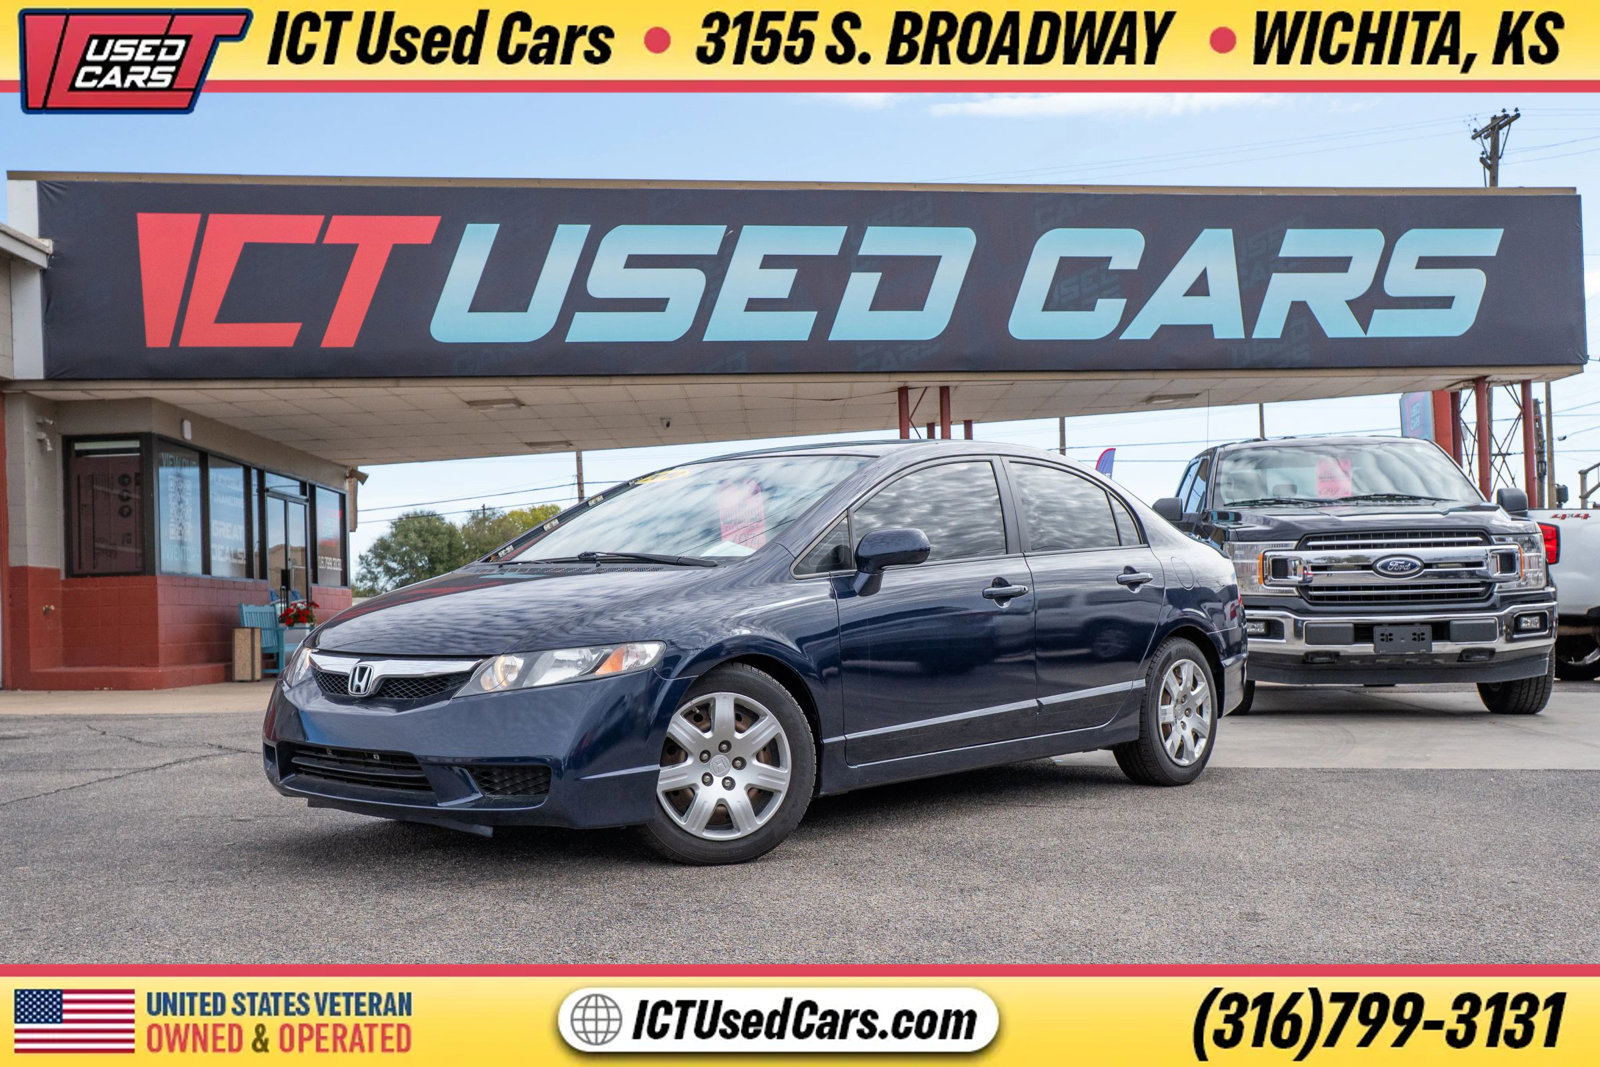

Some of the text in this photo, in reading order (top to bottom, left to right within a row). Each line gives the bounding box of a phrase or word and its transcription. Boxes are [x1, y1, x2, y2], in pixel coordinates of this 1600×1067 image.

[136, 212, 1506, 349] ICT USED CARS
[212, 520, 245, 541] GREAT
[1387, 560, 1411, 571] Ford
